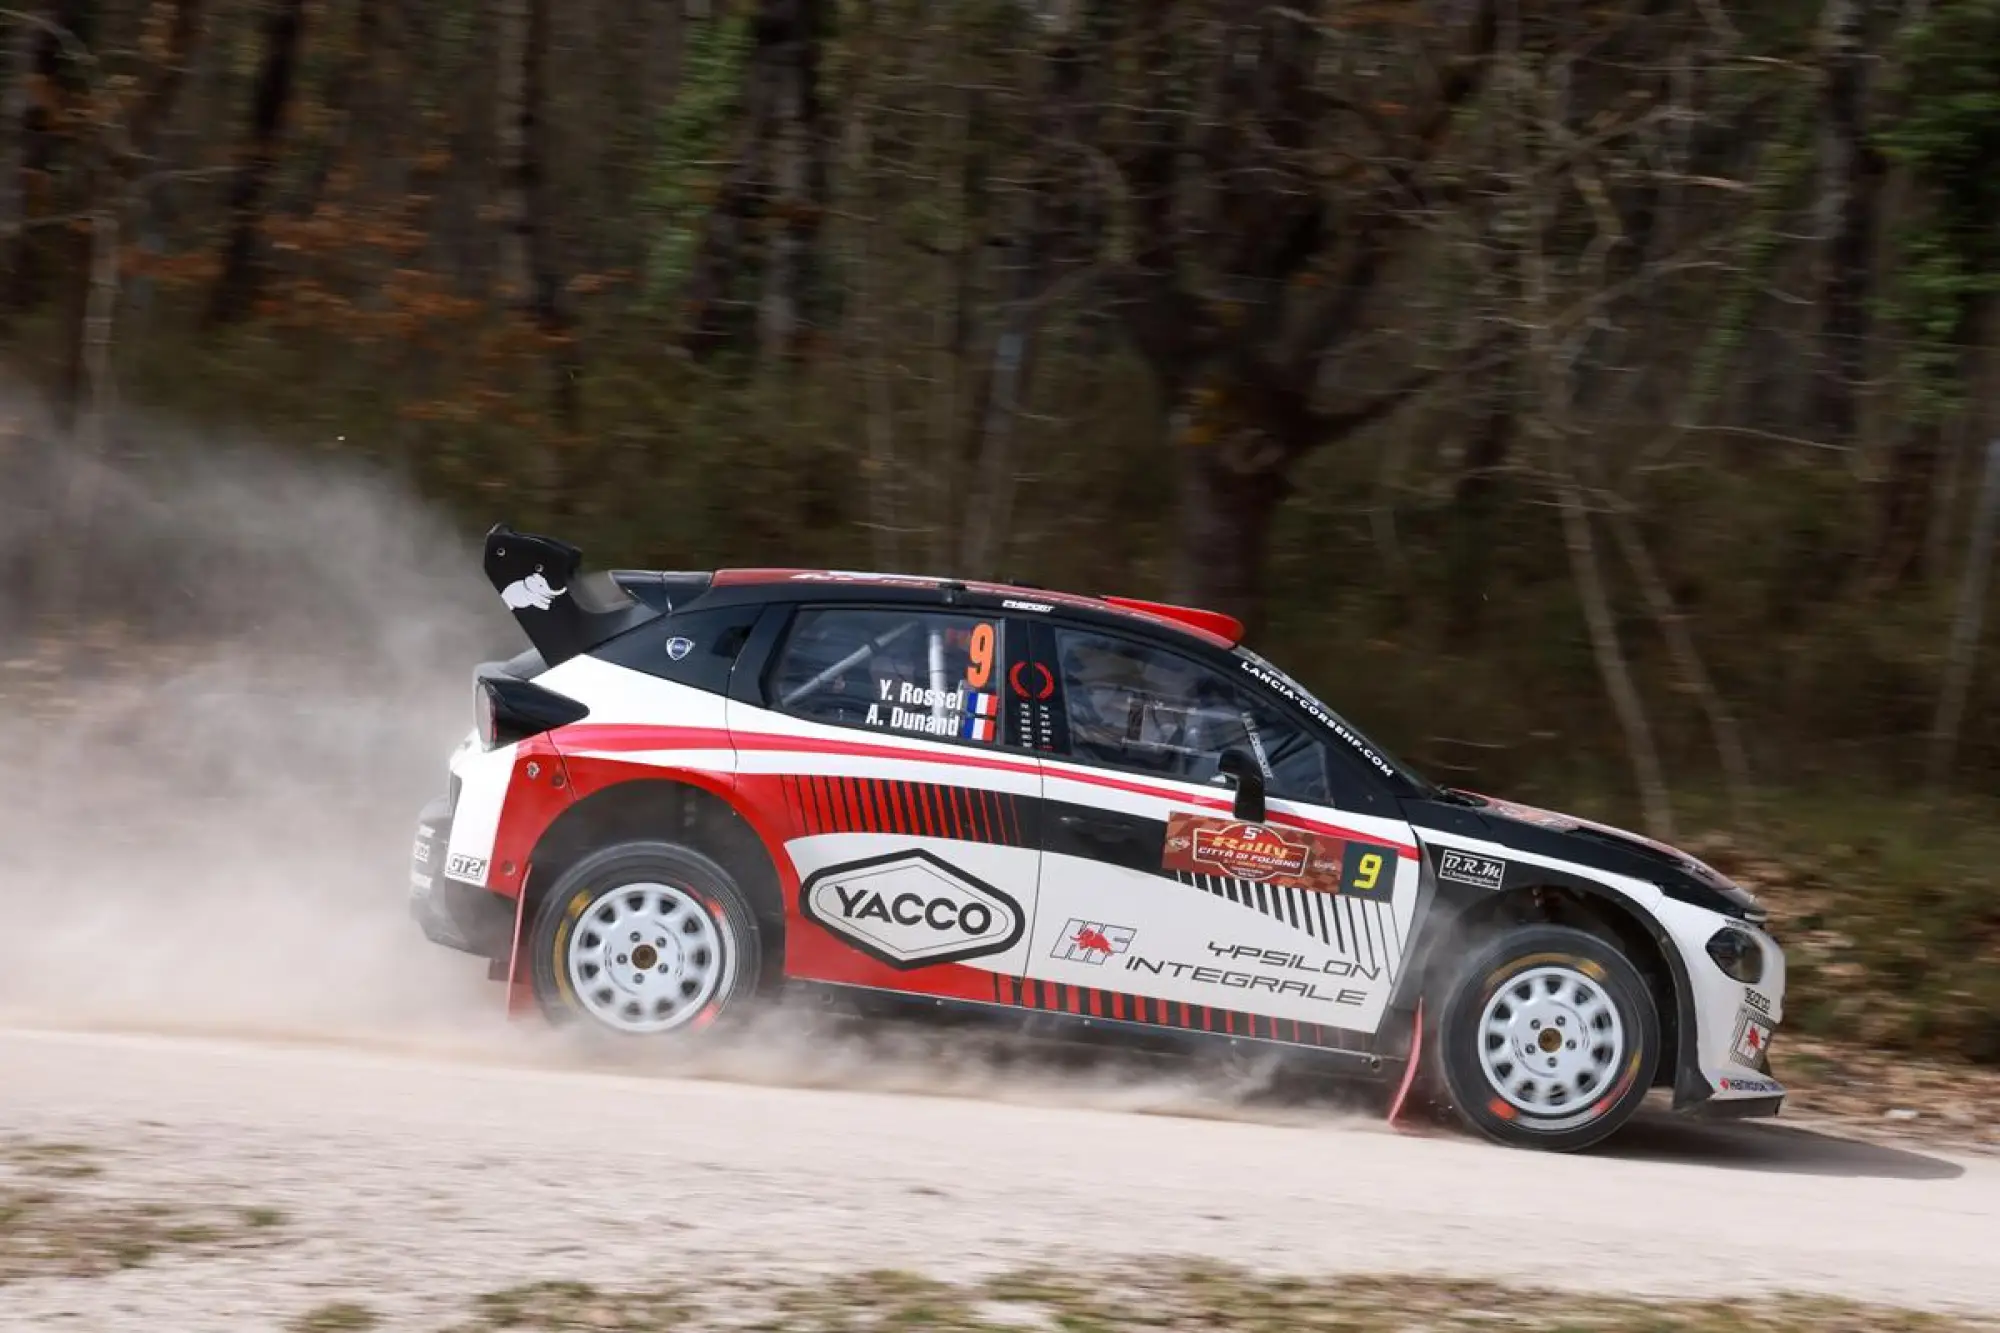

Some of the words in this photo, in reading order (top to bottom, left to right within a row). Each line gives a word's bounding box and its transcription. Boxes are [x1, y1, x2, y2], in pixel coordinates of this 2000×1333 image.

[967, 622, 995, 689] 9
[880, 679, 893, 701] Y.
[900, 681, 964, 711] Rossel
[866, 704, 884, 726] A.
[891, 706, 961, 737] Dunand
[1211, 836, 1289, 858] Rally
[1236, 852, 1249, 861] DI
[1352, 852, 1384, 890] 9
[833, 884, 992, 937] YACCO
[1050, 918, 1138, 966] HF
[1207, 940, 1381, 982] YPSILON
[1125, 955, 1369, 1007] INTEGRALE
